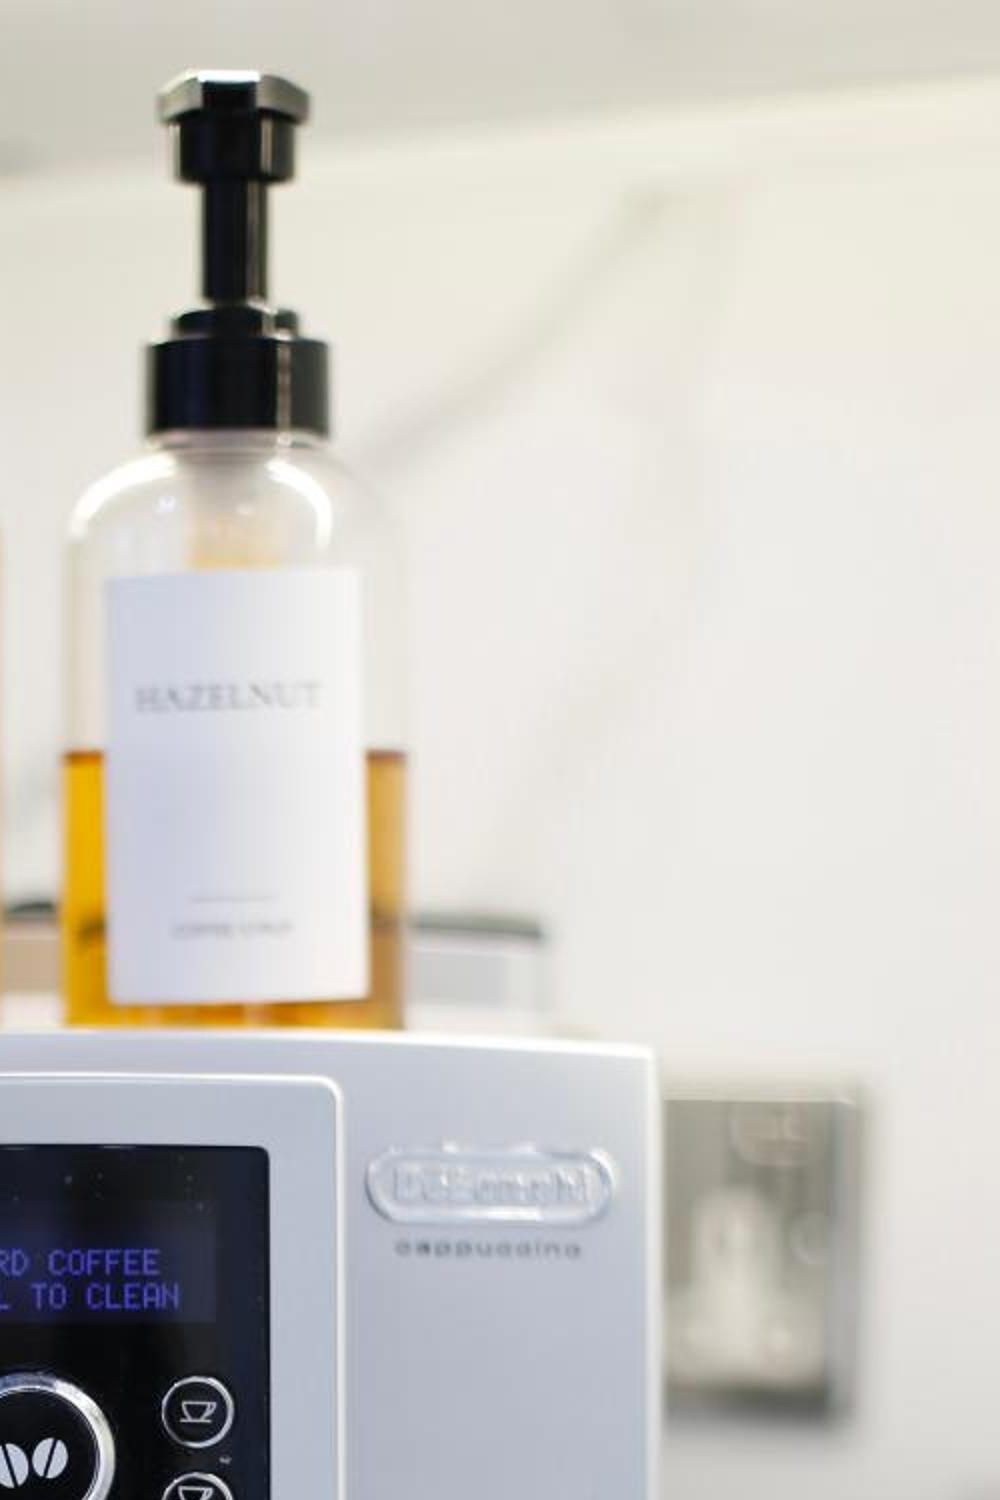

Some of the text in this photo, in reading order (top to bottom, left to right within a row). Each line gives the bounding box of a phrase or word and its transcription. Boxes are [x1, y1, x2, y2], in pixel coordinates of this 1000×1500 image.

[135, 680, 324, 713] HAZELNUT
[48, 1248, 162, 1277] COFFEE
[31, 1282, 68, 1311] TO
[86, 1282, 180, 1311] CLEAN
